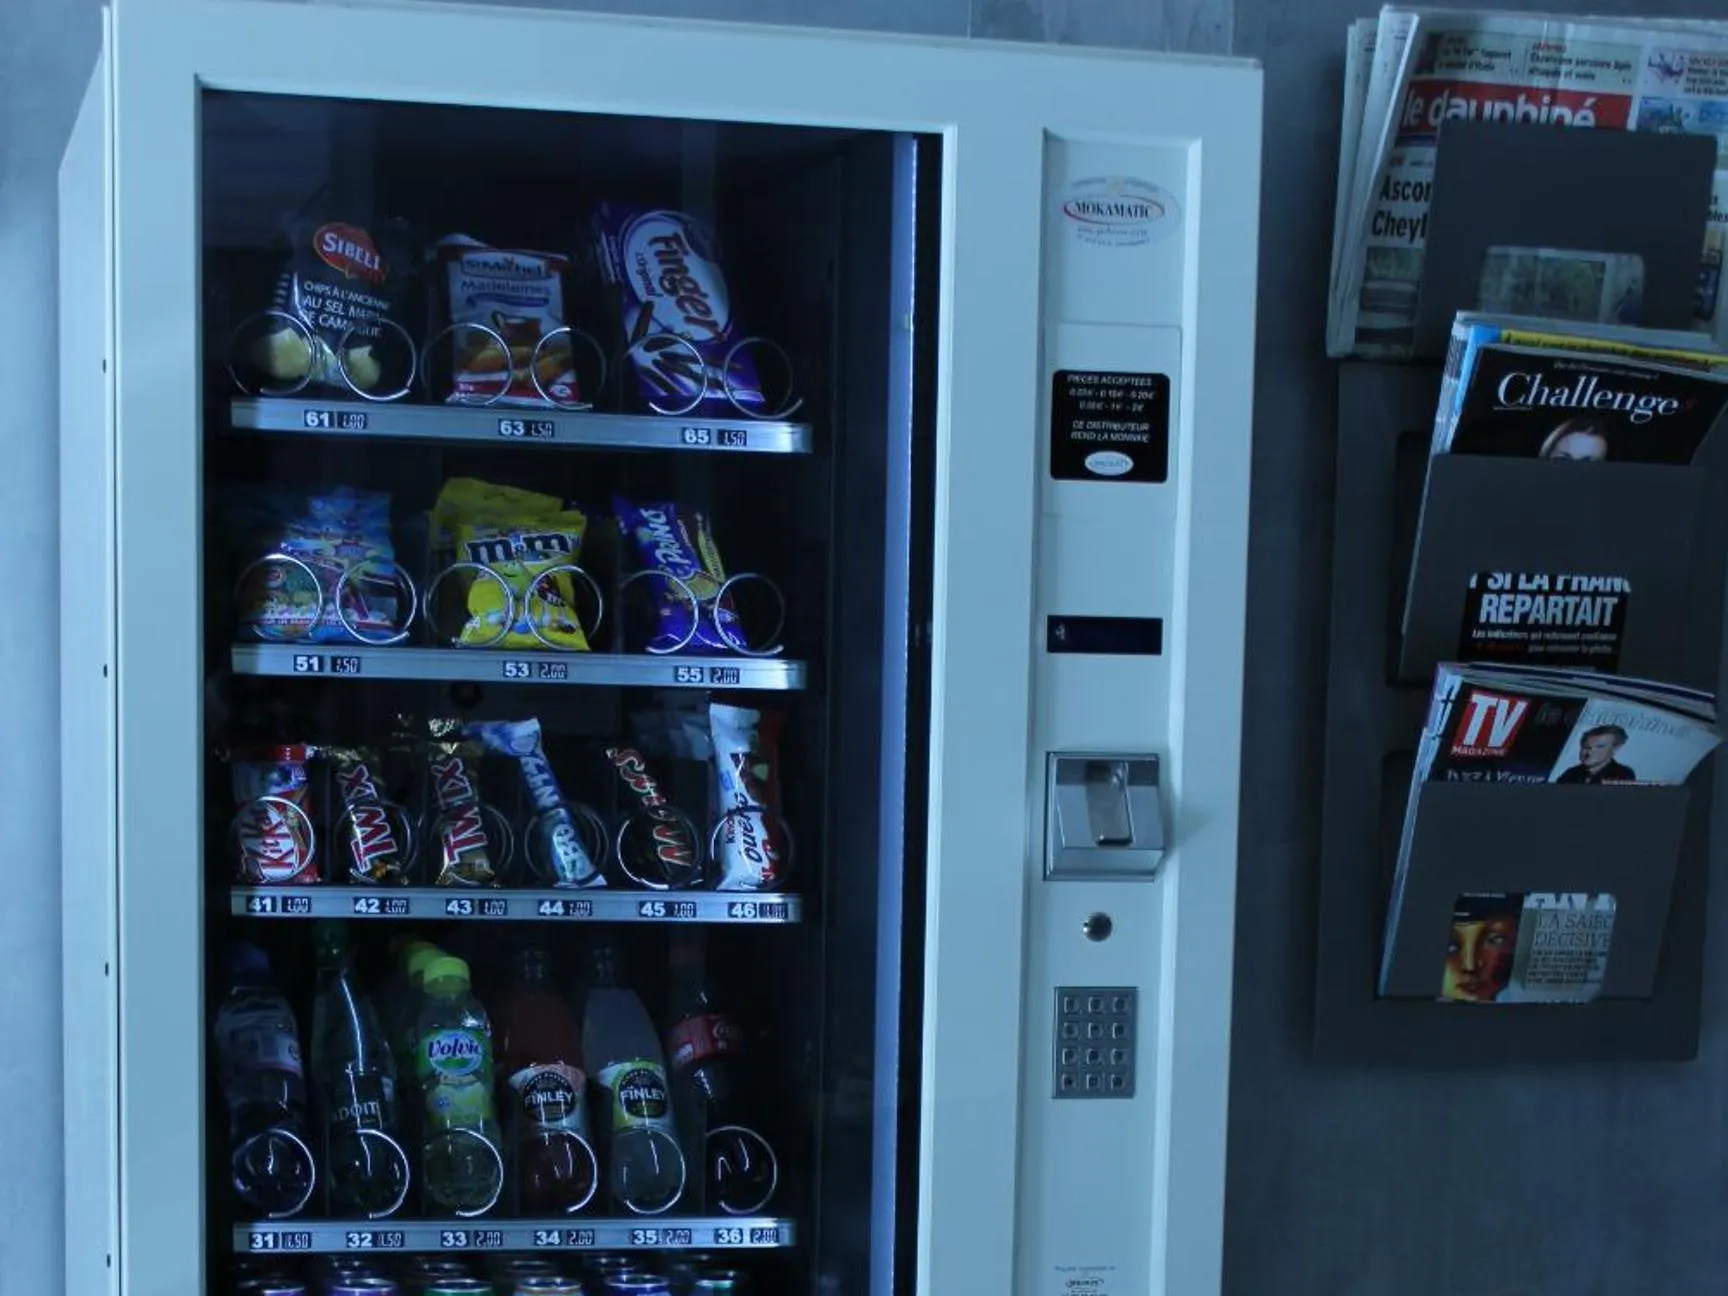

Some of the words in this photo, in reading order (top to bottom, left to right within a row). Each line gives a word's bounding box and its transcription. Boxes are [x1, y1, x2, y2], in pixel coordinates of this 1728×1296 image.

[1075, 200, 1150, 218] MOKAMATIC
[325, 299, 345, 316] SEL
[306, 411, 330, 428] 61
[500, 420, 524, 436] 63
[684, 428, 710, 444] 65
[1479, 593, 1619, 627] REPARTAIT
[296, 656, 320, 672] 51
[505, 662, 530, 677] 53
[678, 667, 702, 682] 55
[1463, 693, 1528, 748] TV
[336, 763, 398, 873] TWIX
[431, 757, 488, 867] TWIX
[249, 897, 272, 911] 41
[355, 898, 380, 913] 42
[447, 900, 472, 915] 43
[539, 900, 564, 915] 44
[640, 902, 665, 917] 45
[731, 902, 755, 917] 46
[523, 1089, 574, 1108] FINLEY
[618, 1086, 666, 1103] FINLEY
[252, 1233, 274, 1249] 31
[348, 1233, 372, 1248] 32
[442, 1231, 467, 1246] 33
[536, 1231, 560, 1245] 34
[633, 1230, 656, 1244] 35
[718, 1229, 741, 1243] 36
